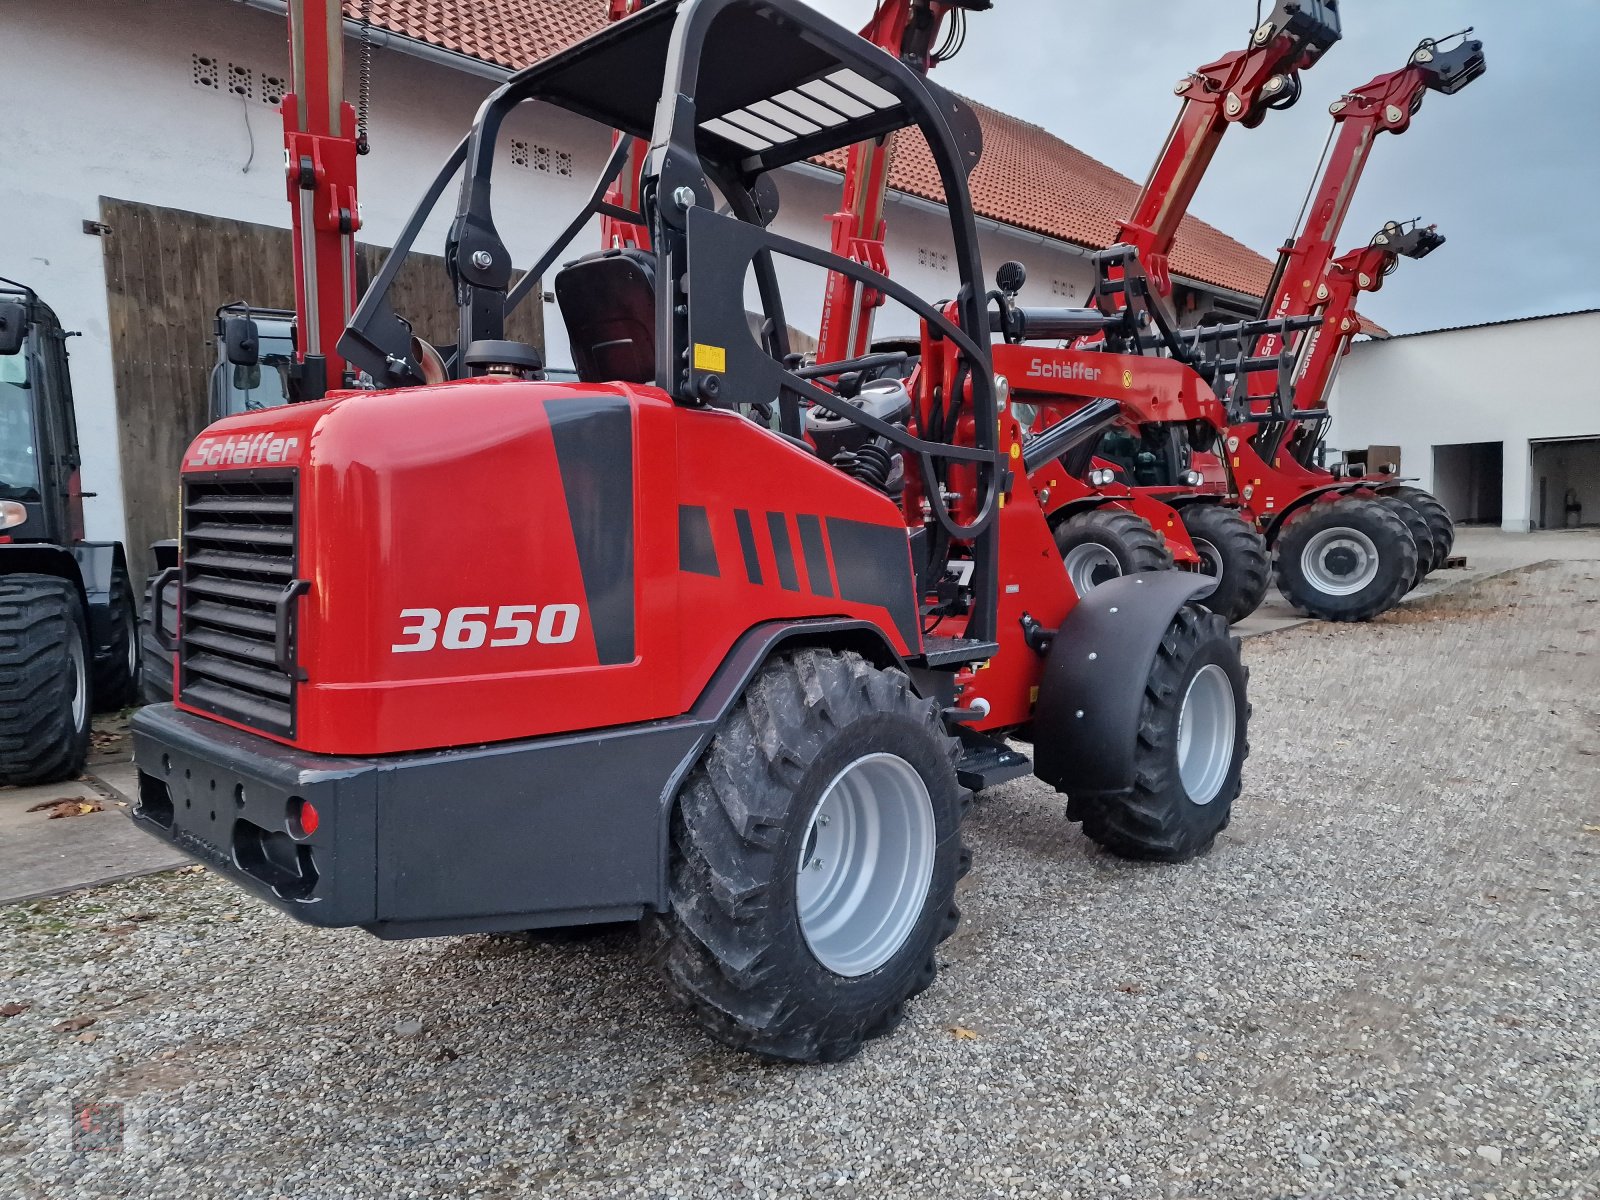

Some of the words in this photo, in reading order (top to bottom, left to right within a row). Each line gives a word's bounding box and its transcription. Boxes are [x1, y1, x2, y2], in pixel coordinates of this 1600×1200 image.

[1026, 358, 1102, 381] Schäffer
[188, 431, 298, 466] Schäffer
[391, 603, 581, 653] 3650
